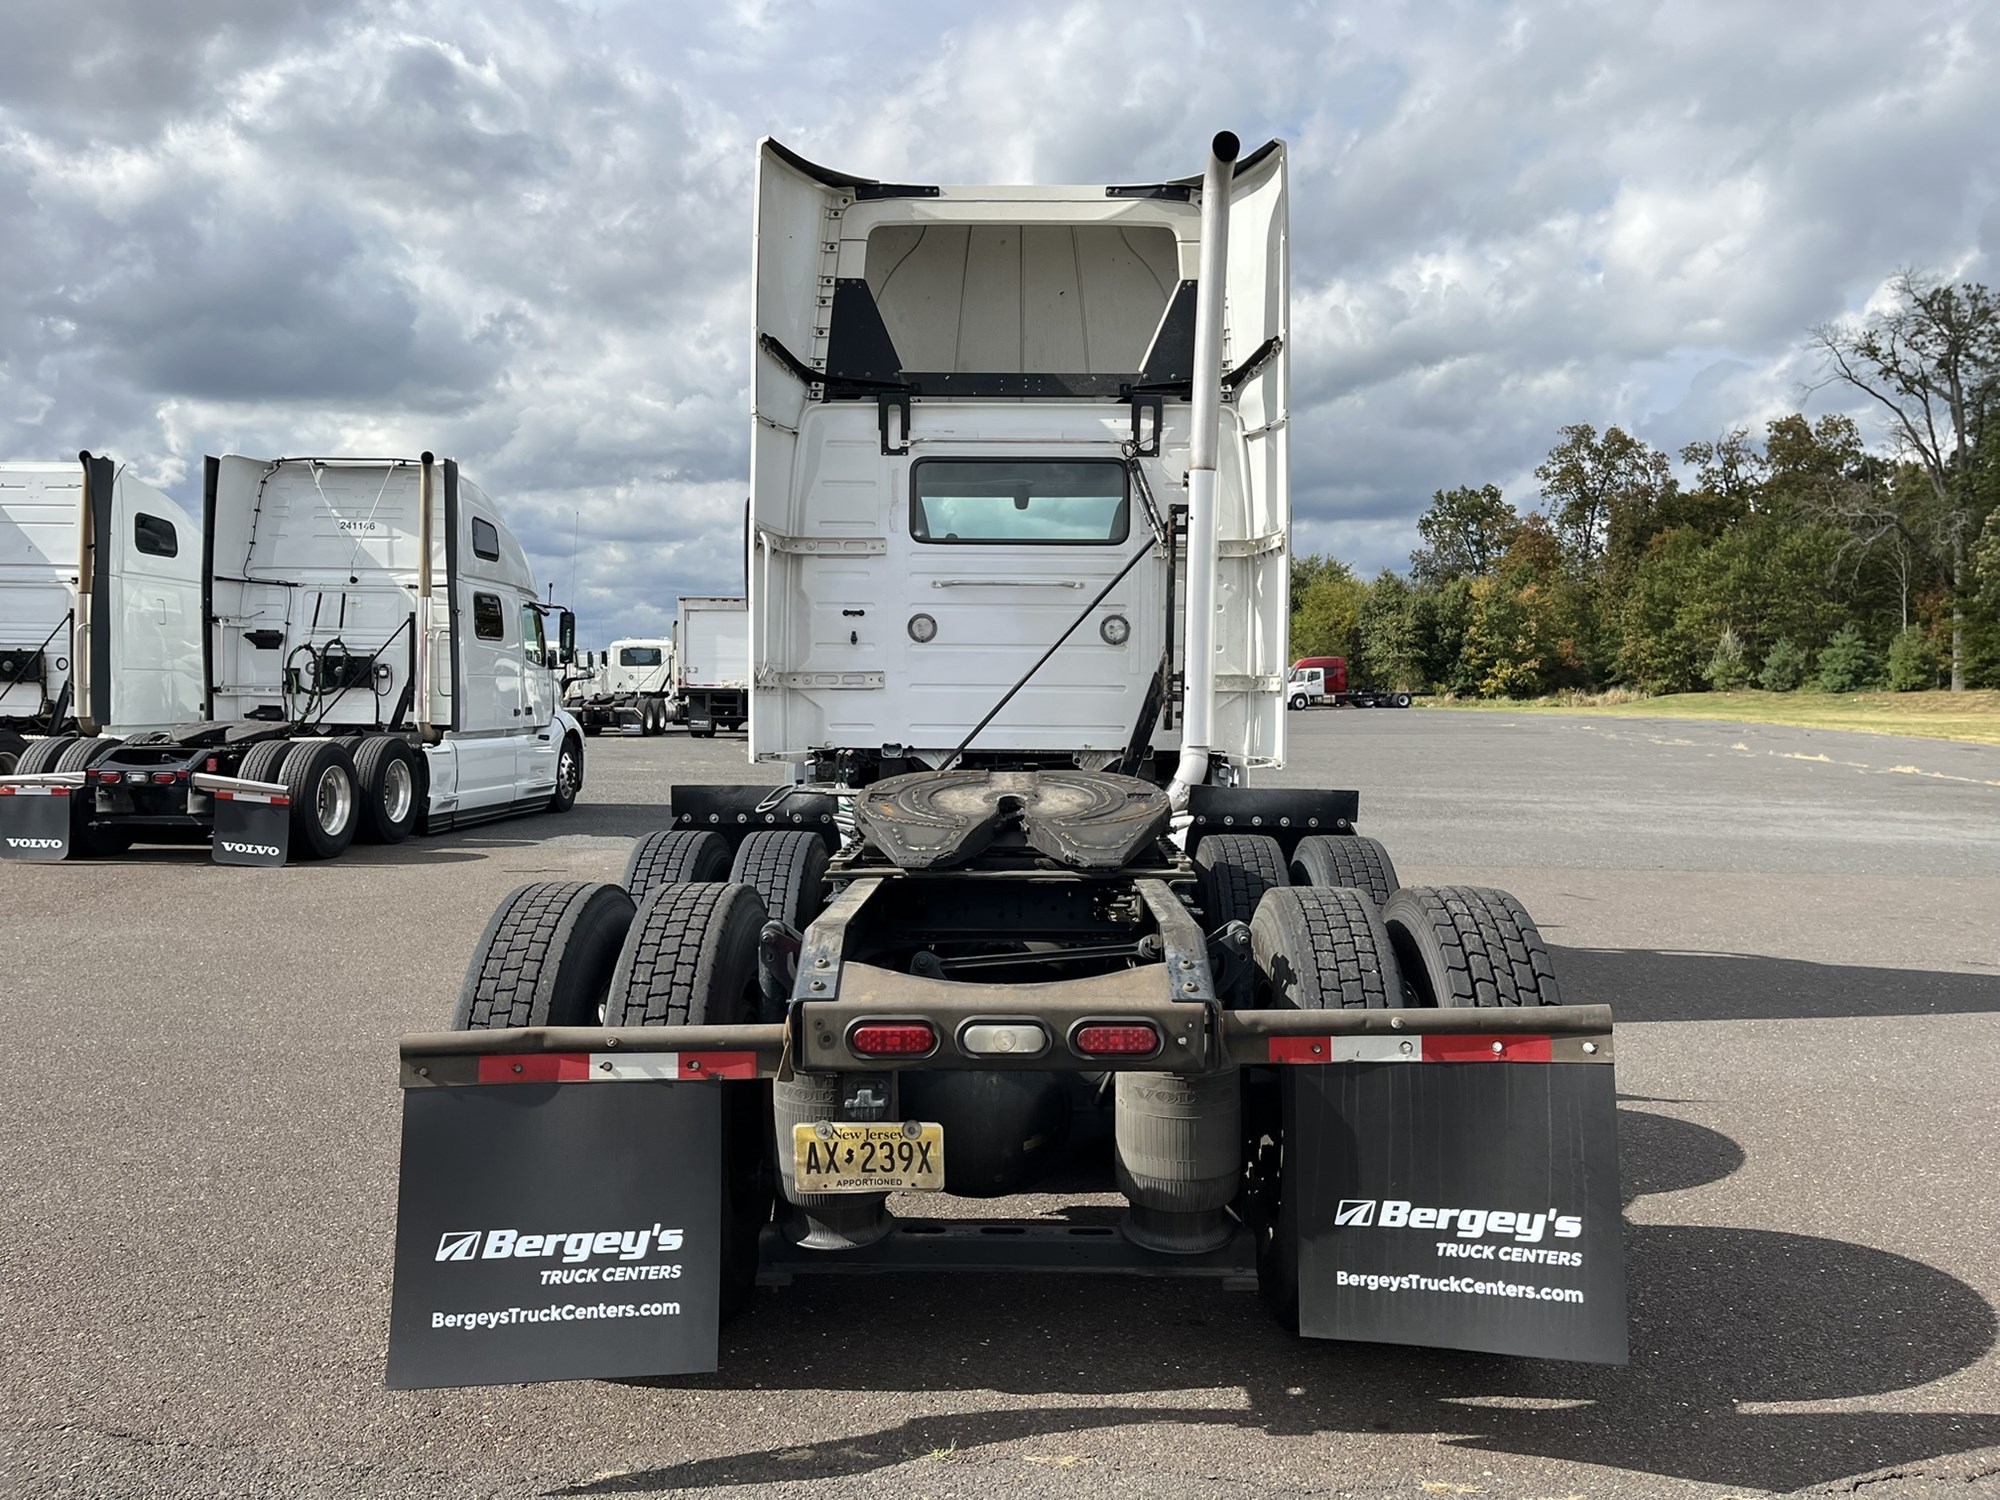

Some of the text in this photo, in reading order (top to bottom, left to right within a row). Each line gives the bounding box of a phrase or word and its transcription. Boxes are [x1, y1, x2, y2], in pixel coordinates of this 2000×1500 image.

[6, 837, 63, 849] VOLVO
[221, 842, 280, 856] VOLVO
[831, 1128, 905, 1142] New Jersey
[806, 1142, 841, 1174] AX
[836, 1178, 903, 1187] APPORTIONED
[1377, 1200, 1583, 1243] Bergey's
[481, 1223, 684, 1263] Bergey's
[1436, 1243, 1583, 1267] TRUCK CENTERS
[540, 1264, 683, 1285] TRUCK CENTERS
[1336, 1271, 1584, 1304] BergeysTruckCenters.com
[431, 1301, 681, 1330] BergeysTruckCenters.com
